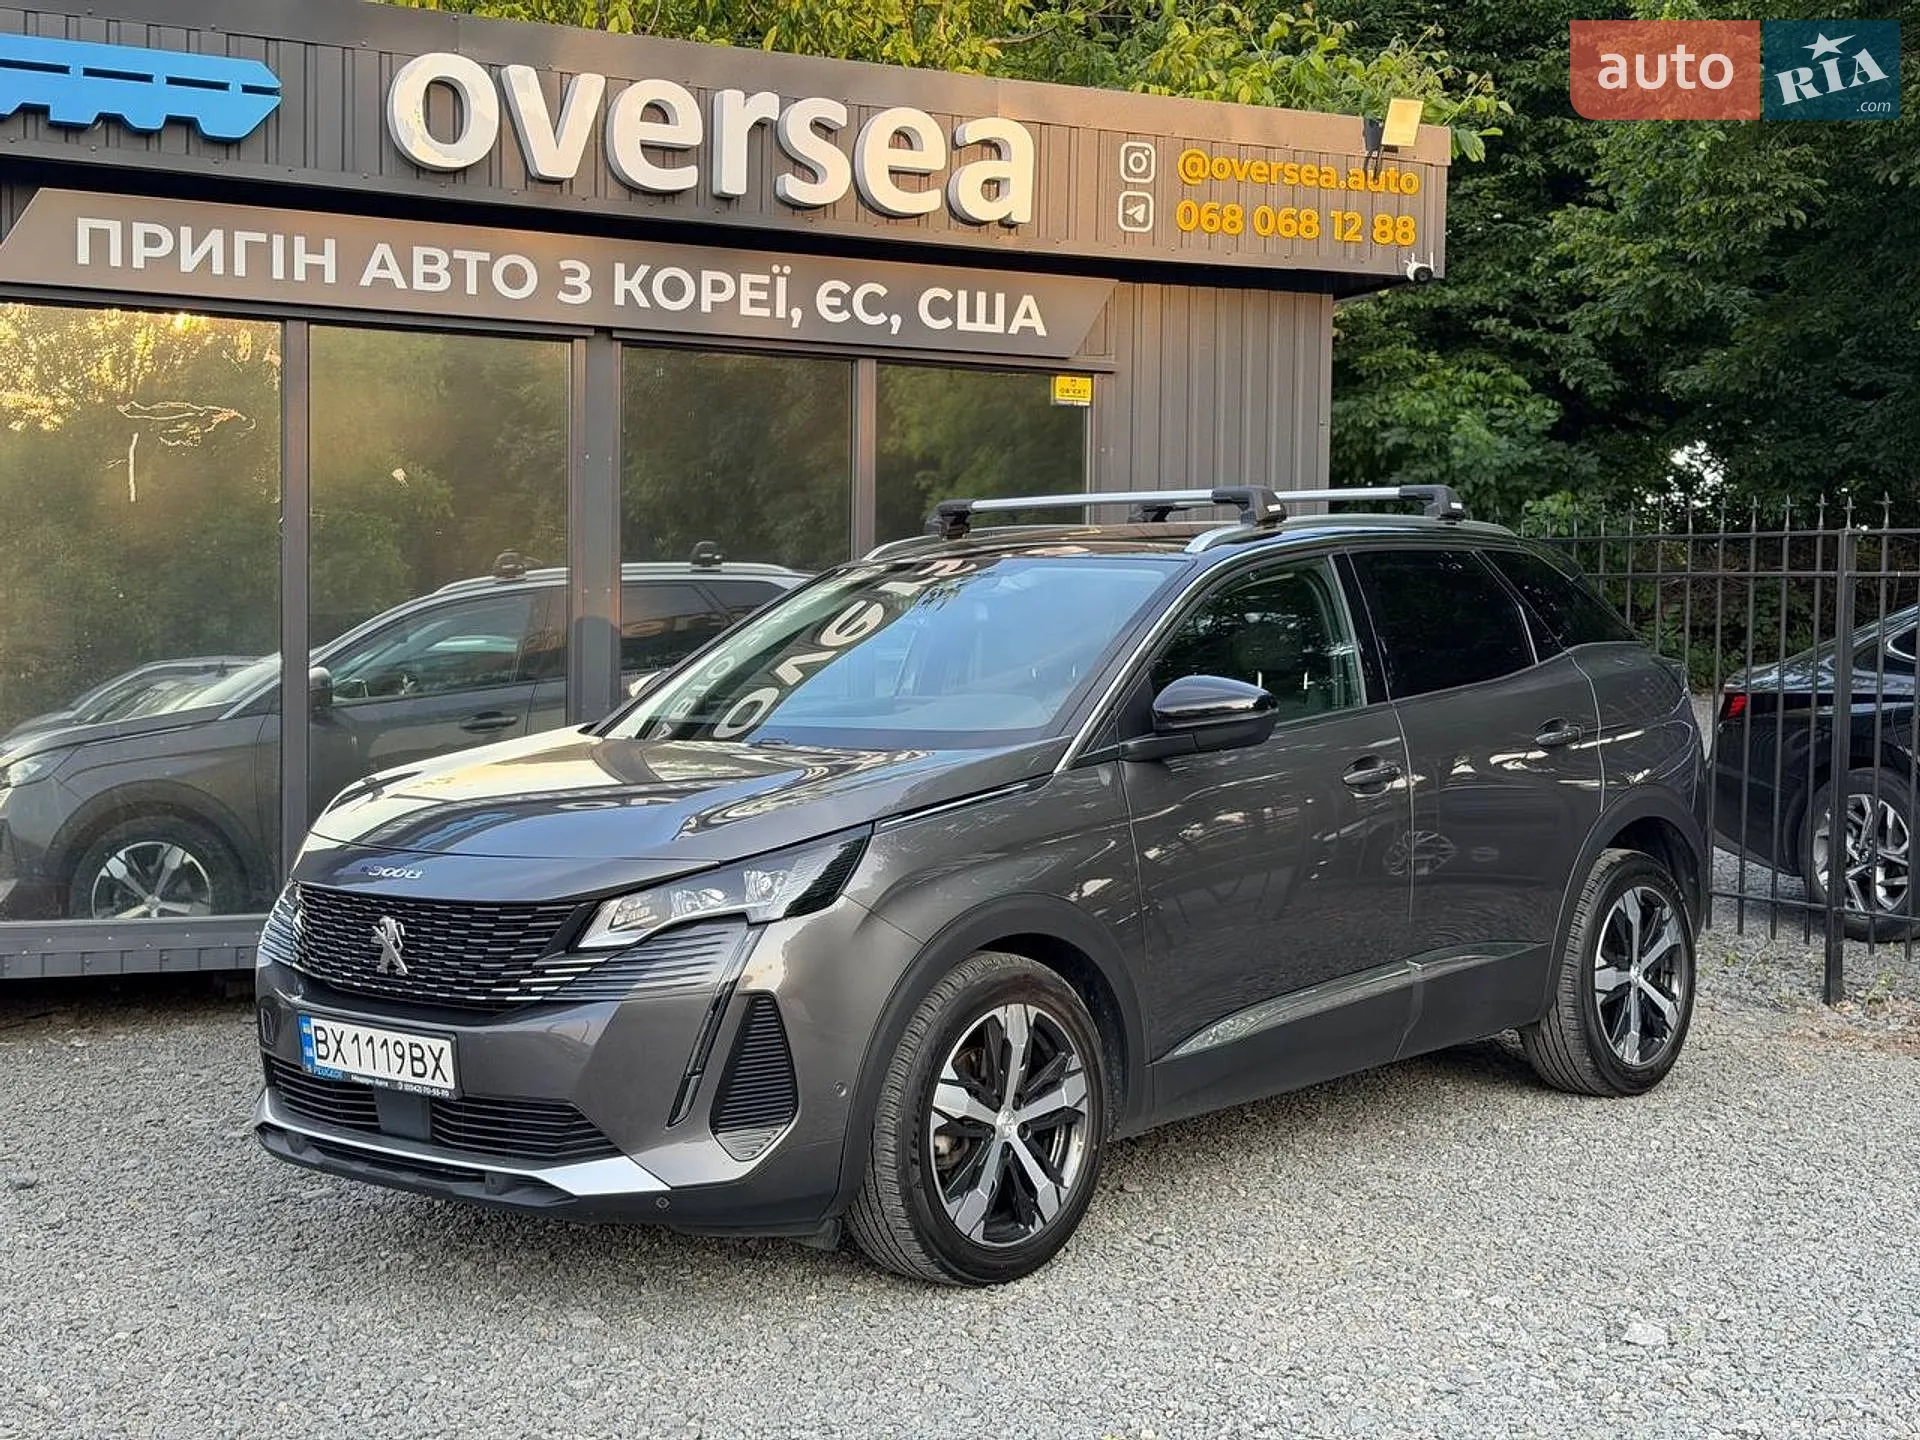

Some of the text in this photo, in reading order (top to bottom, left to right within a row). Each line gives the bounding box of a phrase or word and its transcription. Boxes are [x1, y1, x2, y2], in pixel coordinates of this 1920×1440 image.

[386, 52, 1036, 226] oversea
[1176, 147, 1420, 196] @oversea.auto
[1175, 198, 1417, 247] 068 068 12 88
[77, 217, 337, 284] ПРИГІН
[359, 242, 538, 300] АВТО
[614, 262, 802, 329] КОРЕЇ,
[816, 280, 902, 336] ЄС,
[918, 286, 1047, 337] США
